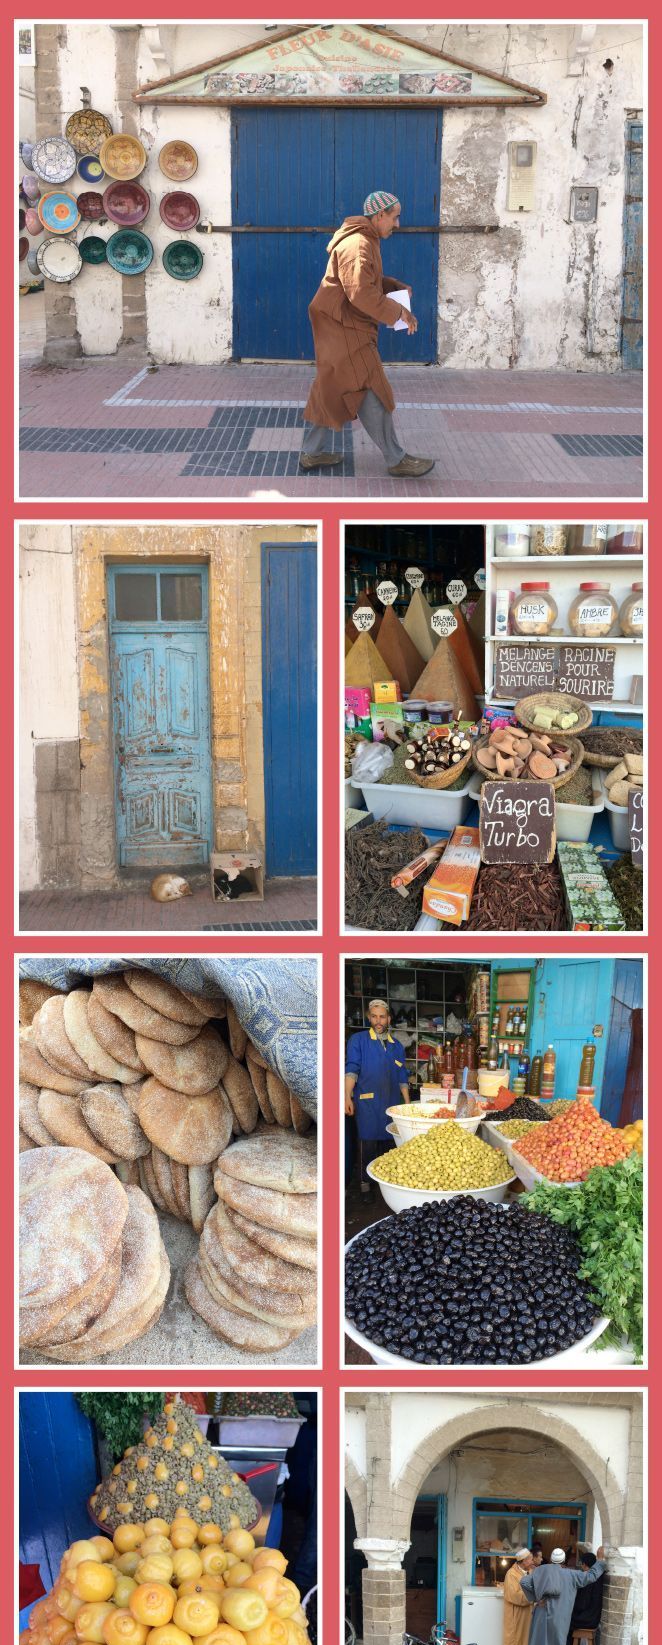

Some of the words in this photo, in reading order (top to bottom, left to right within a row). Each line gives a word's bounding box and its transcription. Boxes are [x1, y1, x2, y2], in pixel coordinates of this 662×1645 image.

[266, 29, 332, 60] FLEUR
[340, 29, 404, 63] D'ASIE
[448, 584, 464, 593] CURRY
[353, 613, 375, 621] SAFRAN
[580, 608, 609, 619] AMBRE
[499, 648, 555, 662] MELANGE
[564, 648, 614, 663] RACINE
[566, 663, 601, 676] POUR
[500, 674, 554, 687] NATUREL
[559, 677, 614, 695] SOURIRE
[483, 790, 553, 827] Viagra
[484, 821, 540, 847] Turbo
